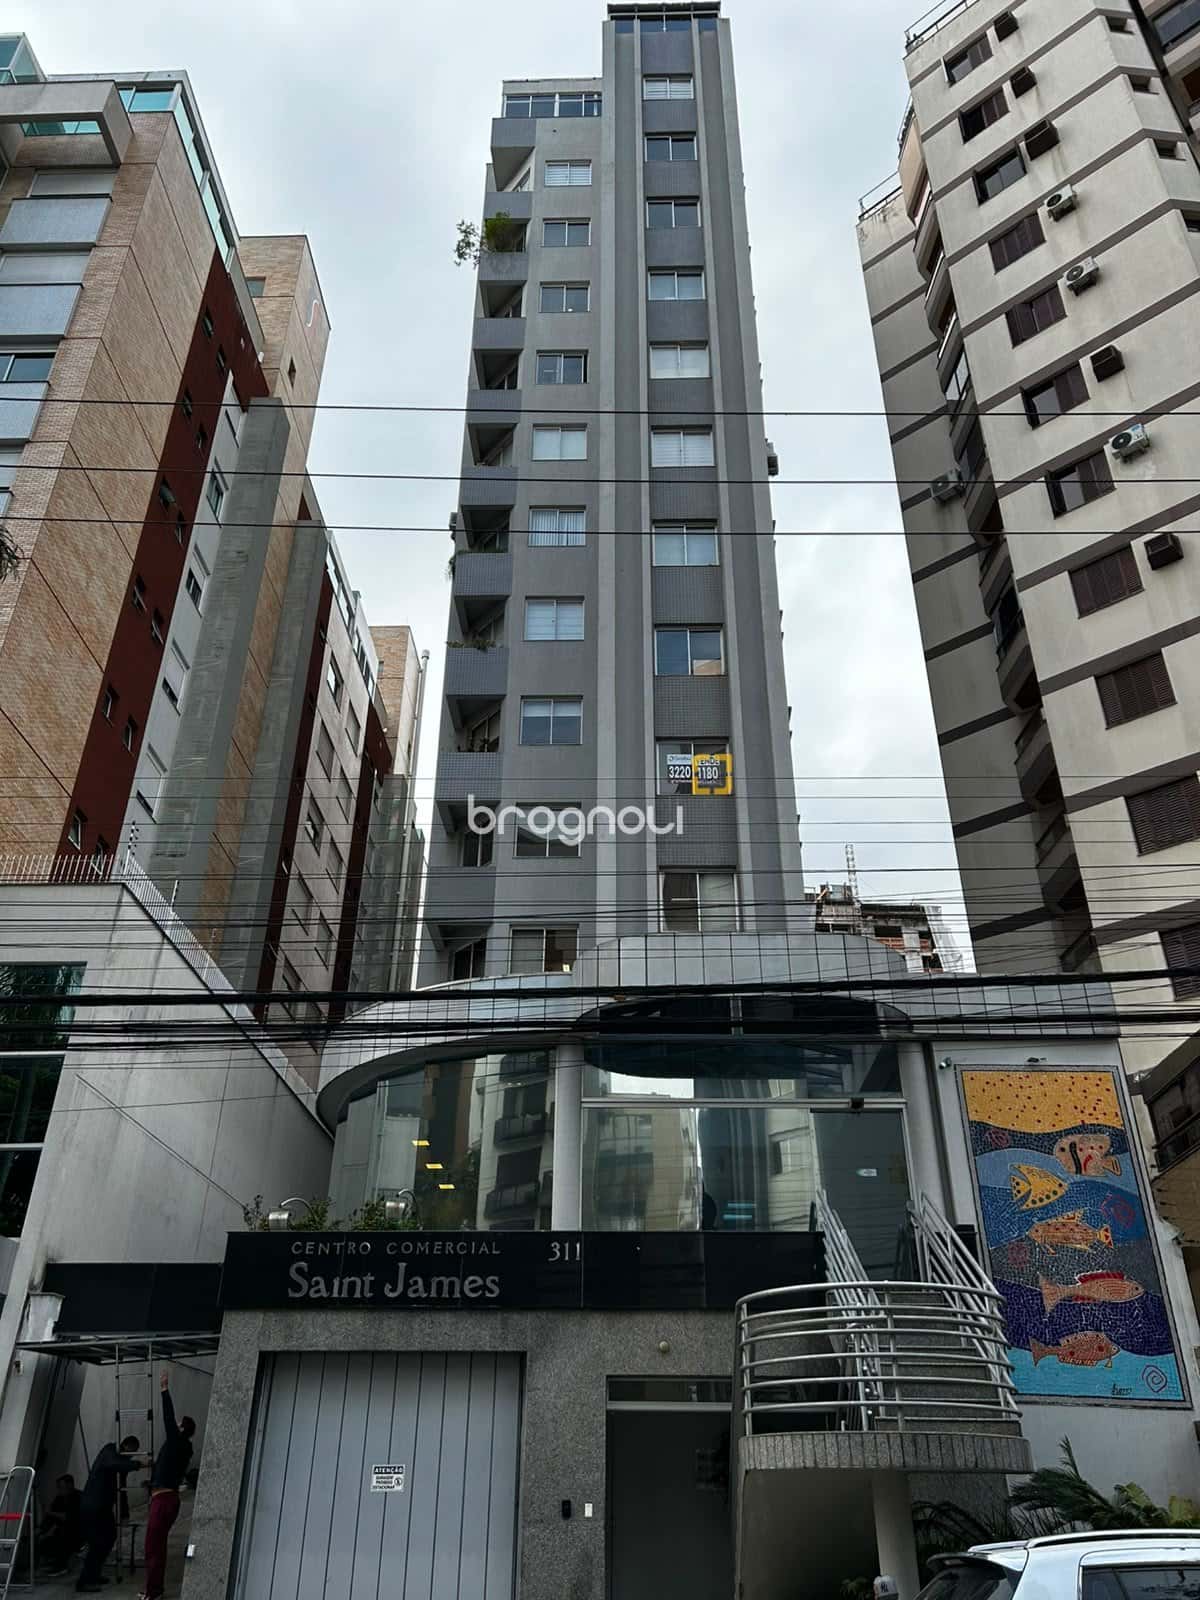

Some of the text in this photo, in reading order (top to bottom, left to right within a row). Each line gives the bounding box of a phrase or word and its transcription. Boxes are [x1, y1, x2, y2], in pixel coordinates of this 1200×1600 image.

[668, 766, 719, 779] 3220 1180
[290, 1241, 501, 1256] CENTRO COMERCIAL
[548, 1241, 581, 1262] 311
[287, 1261, 500, 1298] Saint James
